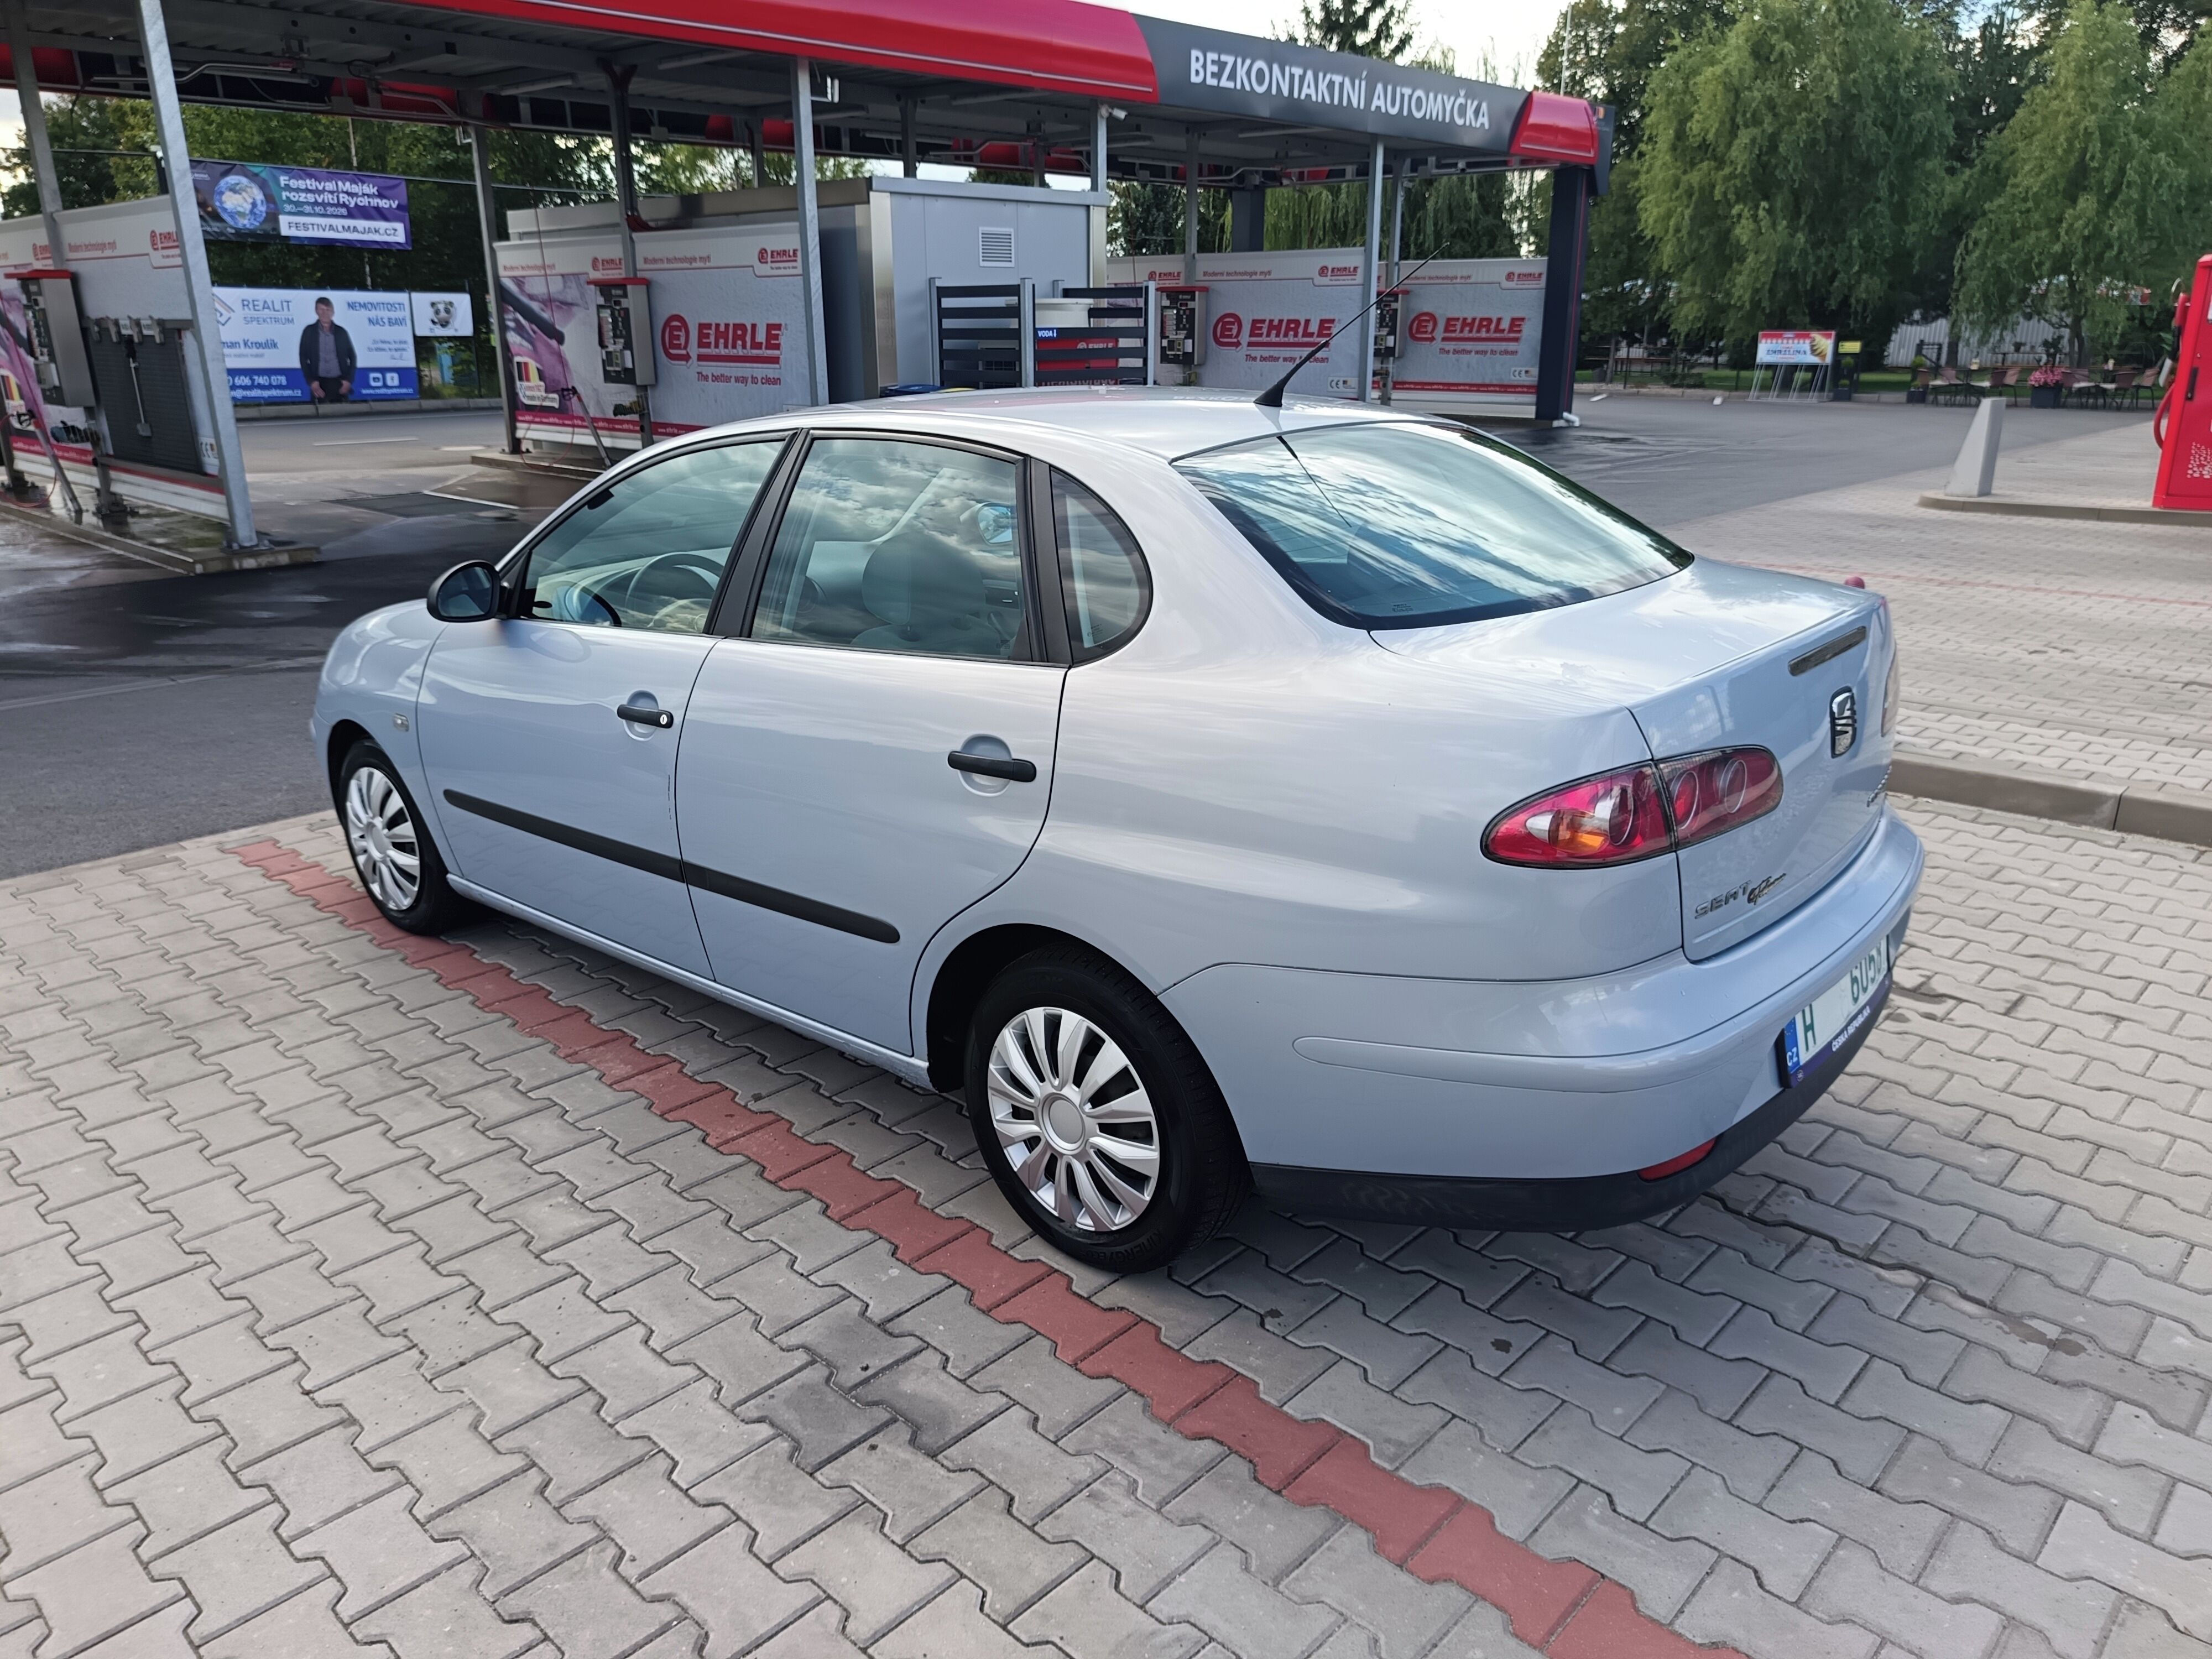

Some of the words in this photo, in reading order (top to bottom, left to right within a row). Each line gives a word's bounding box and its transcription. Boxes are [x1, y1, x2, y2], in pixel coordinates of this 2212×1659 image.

[1190, 49, 1368, 110] BEZKONTAKTNÍ
[1370, 82, 1489, 129] AUTOMYČKA
[279, 175, 337, 191] Festival
[338, 180, 378, 196] Maják
[282, 189, 338, 204] rozsvítí
[339, 194, 399, 210] Rychnov
[288, 221, 399, 237] FESTIVALMAJAK.CZ
[159, 231, 178, 243] EHRL
[770, 249, 798, 259] EHRLE
[1331, 266, 1359, 274] EHRLE
[241, 299, 292, 312] REALIT
[347, 301, 405, 312] NEMOVITOSTI
[243, 316, 295, 325] SPEKTRUM
[368, 315, 385, 326] NÁS
[388, 316, 407, 327] BAVÍ
[1443, 317, 1526, 335] EHRLE
[1248, 319, 1336, 339] EHRLE
[222, 340, 241, 349] man
[697, 323, 782, 351] EHRLE
[1245, 354, 1258, 363] The
[1260, 354, 1281, 363] better
[1282, 357, 1297, 365] way
[234, 375, 252, 385] 606
[254, 375, 269, 385] 740
[270, 375, 287, 385] 078
[697, 372, 709, 382] The
[711, 372, 732, 384] better
[734, 375, 749, 387] way
[751, 374, 759, 385] to
[760, 374, 781, 385] clean
[1694, 879, 1752, 920] SEAT
[1801, 1003, 1817, 1052] H
[1786, 1046, 1798, 1067] CZ
